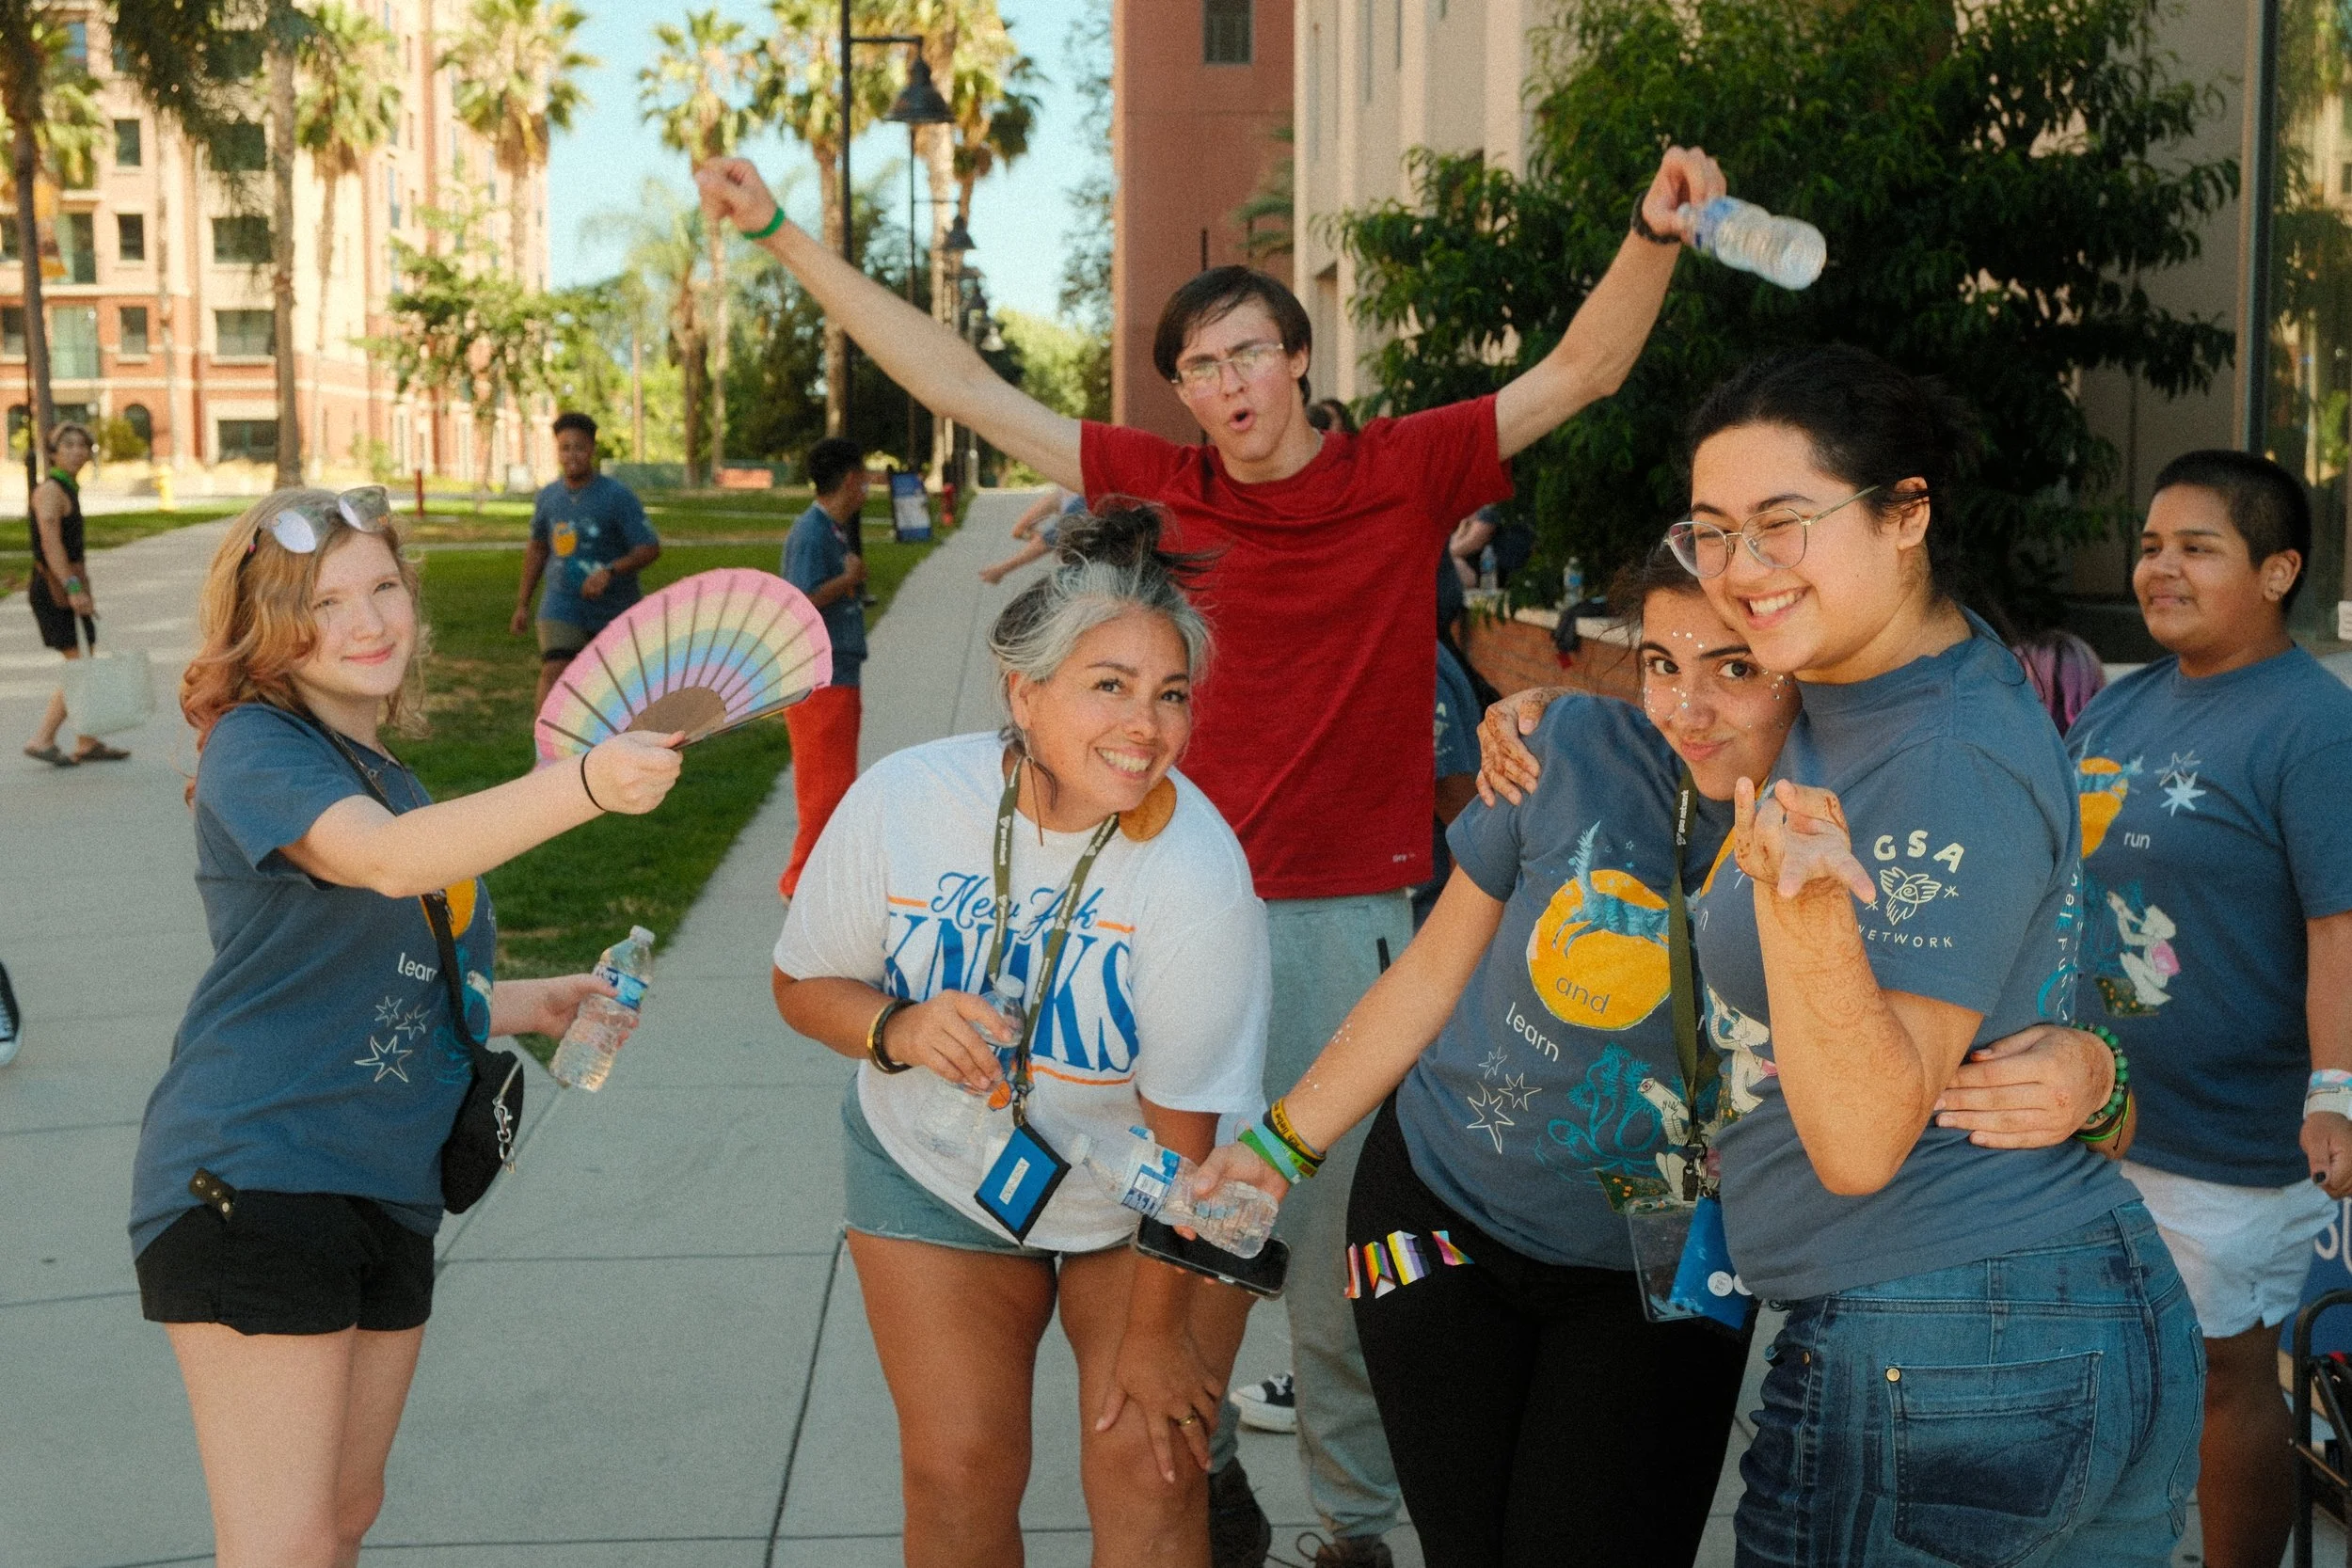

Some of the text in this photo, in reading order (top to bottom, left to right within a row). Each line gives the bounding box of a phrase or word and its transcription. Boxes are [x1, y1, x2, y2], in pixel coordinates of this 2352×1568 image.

[1874, 830, 1965, 874] GSA
[2123, 832, 2151, 849] run
[1019, 887, 1104, 941] Yk
[1556, 976, 1610, 1015] and
[1505, 1001, 1560, 1063] learn
